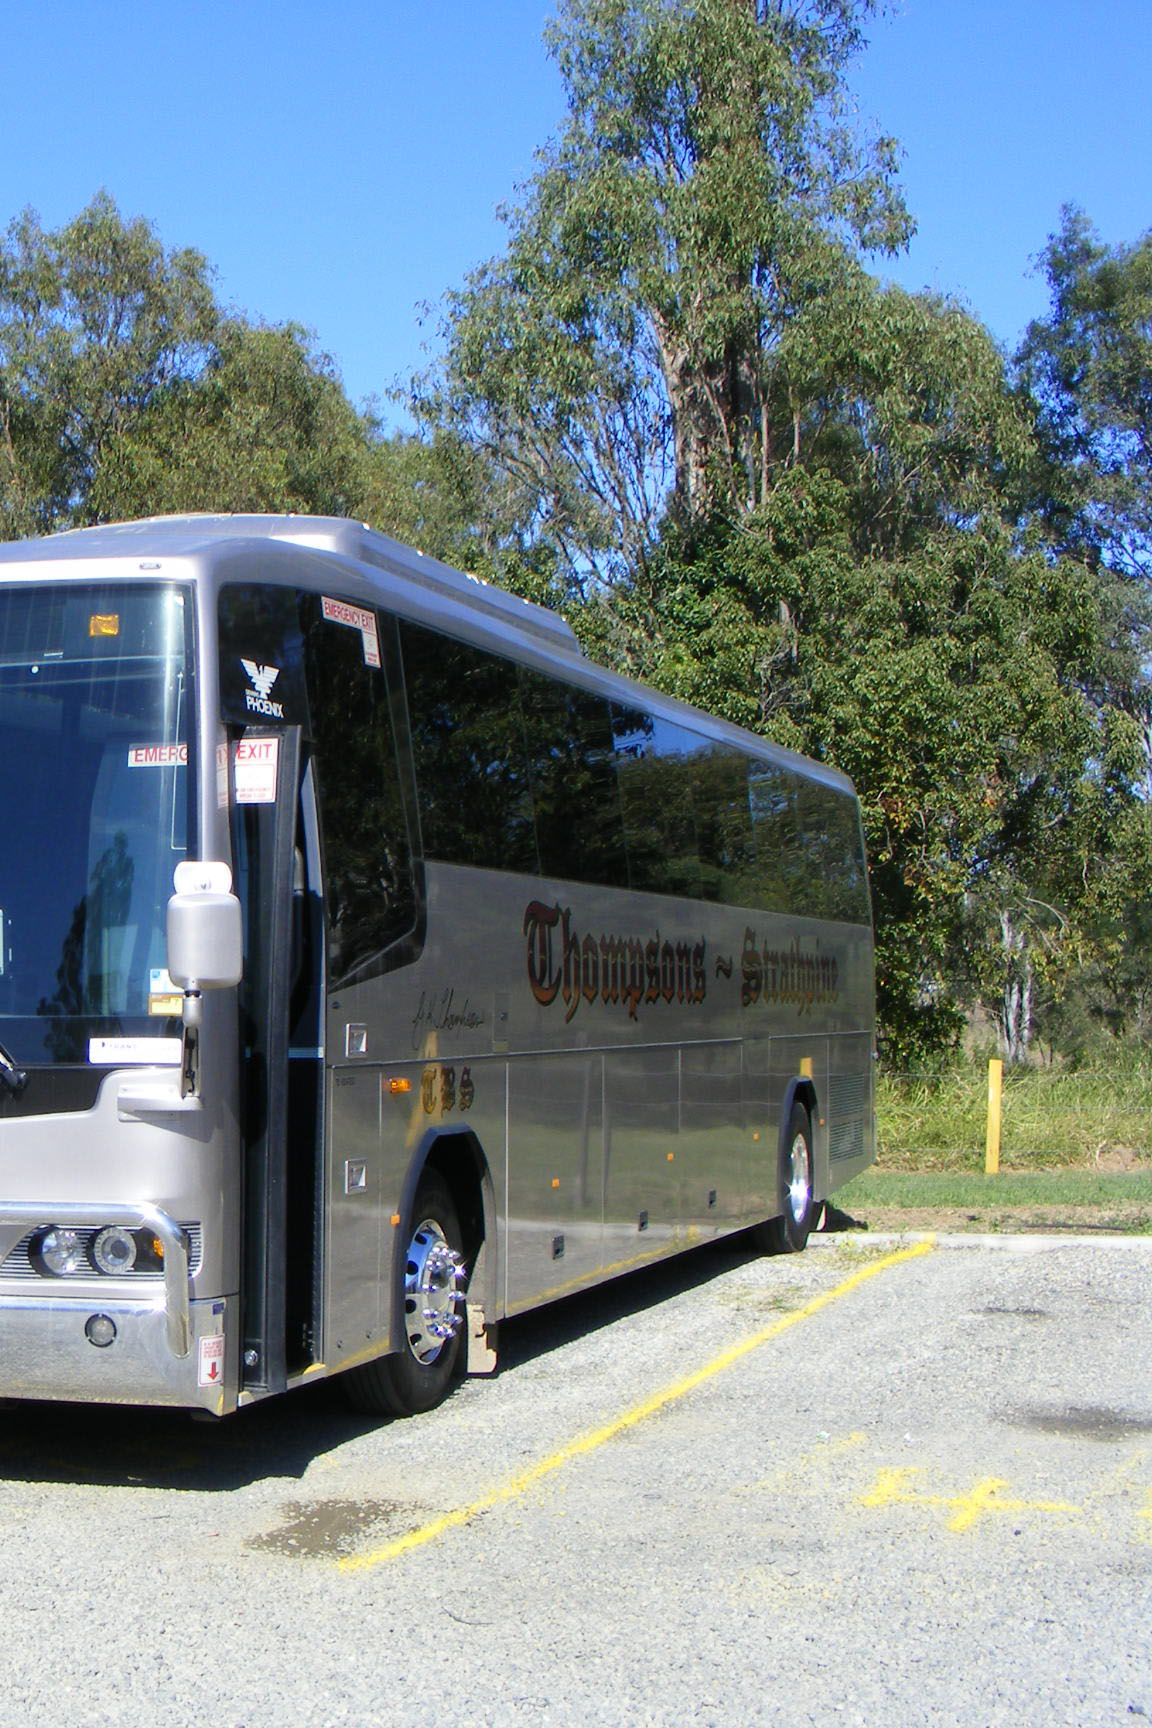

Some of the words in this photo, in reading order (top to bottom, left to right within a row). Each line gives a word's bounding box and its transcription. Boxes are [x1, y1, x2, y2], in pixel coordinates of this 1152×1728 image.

[246, 695, 284, 719] PHOENIX
[134, 745, 188, 763] EMERG
[237, 743, 272, 760] EXIT
[523, 900, 706, 1024] Thompsons
